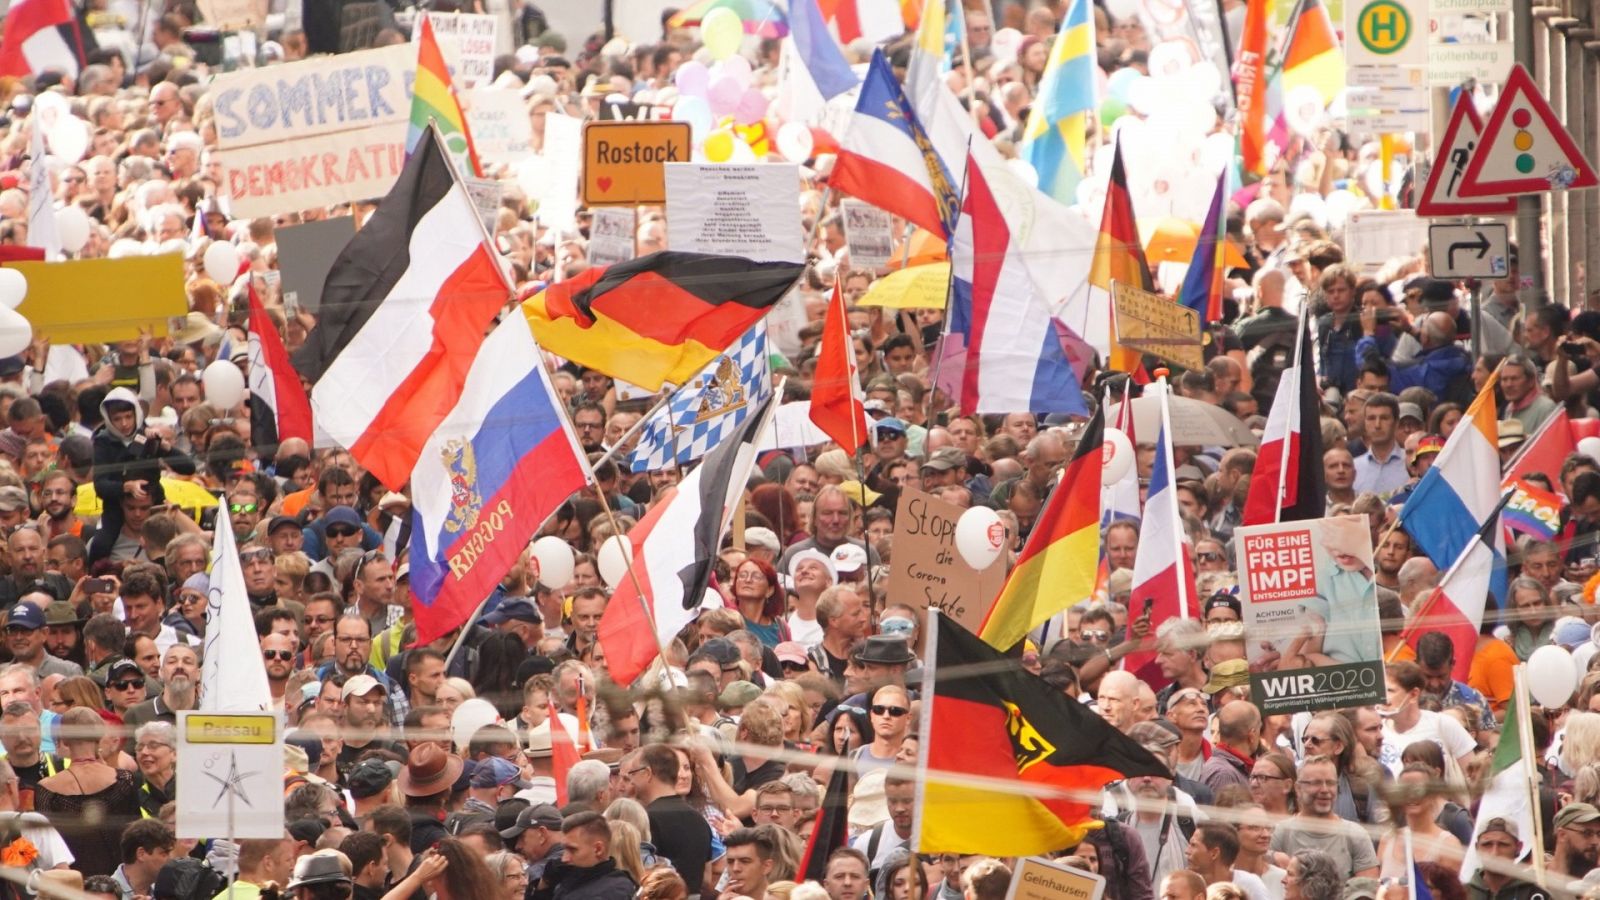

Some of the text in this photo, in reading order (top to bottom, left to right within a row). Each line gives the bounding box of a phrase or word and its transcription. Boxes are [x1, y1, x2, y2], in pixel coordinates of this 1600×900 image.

[1371, 11, 1397, 42] H
[215, 65, 395, 138] SOMMER
[597, 138, 679, 164] Rostock
[1247, 533, 1311, 551] FÜR EINE
[935, 547, 954, 565] die
[1249, 547, 1313, 570] FREIE
[907, 563, 947, 585] Corona
[1251, 567, 1314, 591] IMPF
[1252, 588, 1315, 601] ENTSCHEIDUNG!
[203, 721, 261, 737] Passau
[1023, 871, 1089, 898] Gelnhausen
